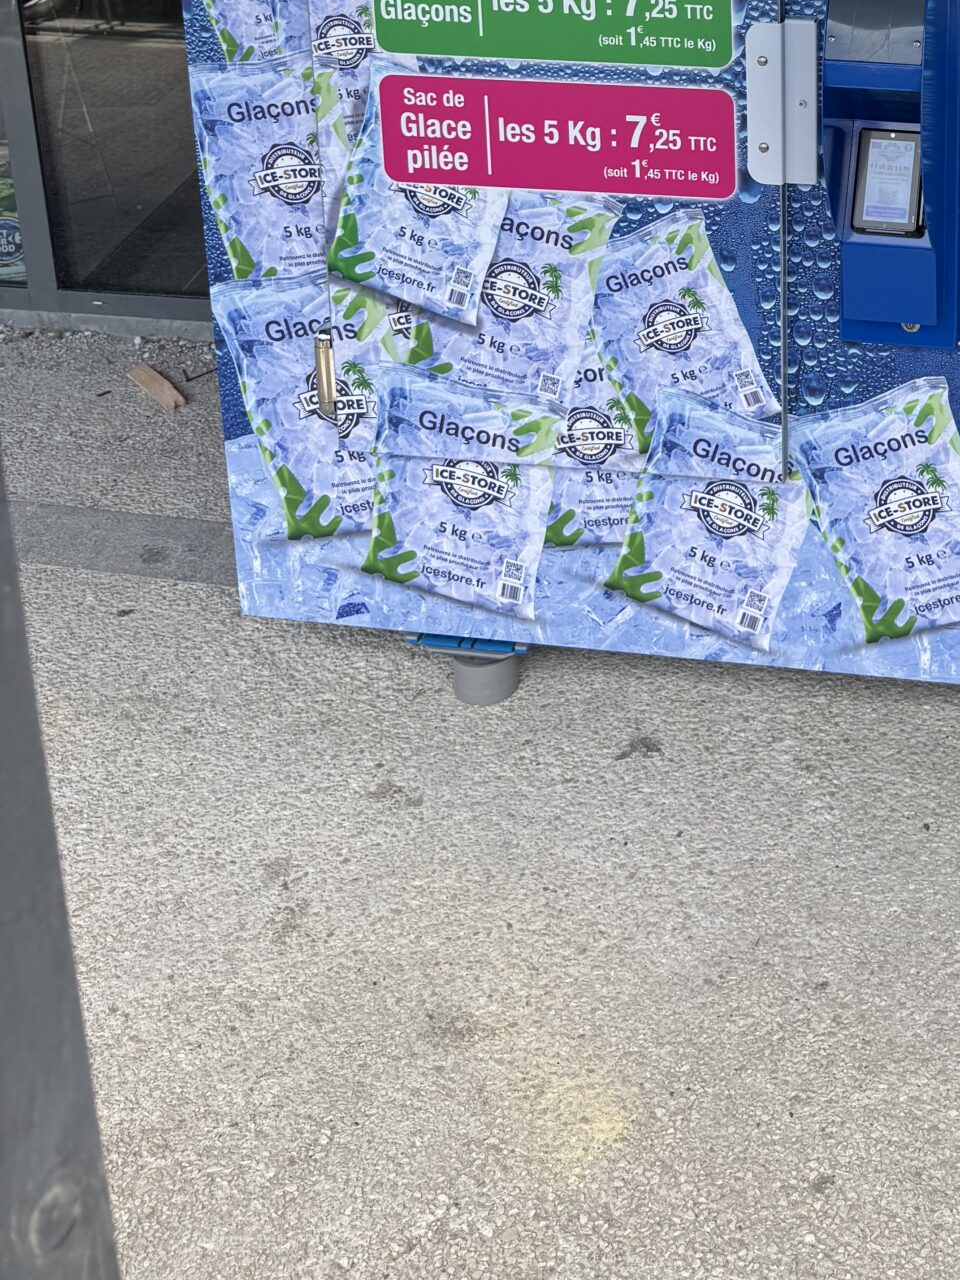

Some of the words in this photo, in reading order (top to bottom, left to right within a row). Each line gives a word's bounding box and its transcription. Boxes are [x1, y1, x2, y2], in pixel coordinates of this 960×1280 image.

[685, 4, 713, 20] TTC
[313, 38, 373, 53] ICE-STORE
[599, 34, 623, 48] (soit
[660, 37, 681, 48] TTC
[685, 38, 694, 49] le
[698, 38, 716, 52] Kg)
[403, 87, 437, 106] Sac
[443, 90, 464, 107] de
[401, 113, 471, 139] Glace
[498, 118, 535, 143] les
[544, 120, 559, 144] 5
[569, 120, 601, 151] Kg
[689, 137, 716, 152] TTC
[407, 145, 468, 173] pilée
[604, 167, 628, 180] (soit
[664, 170, 684, 181] TTC
[688, 171, 697, 181] le
[701, 171, 720, 185] Kg)
[284, 225, 292, 238] 5
[297, 224, 312, 238] kg
[398, 226, 407, 237] 5
[410, 229, 424, 246] kg
[606, 256, 688, 293] Glaçons
[643, 316, 700, 342] ICE-STORE
[477, 333, 485, 345] 5
[489, 336, 505, 353] kg
[671, 373, 679, 384] 5
[682, 370, 697, 381] kg
[419, 410, 520, 452] Glaçons
[335, 450, 344, 463] 5
[835, 429, 929, 467] Glaçons
[435, 468, 505, 496] ICE-STORE
[586, 471, 593, 483] 5
[597, 470, 613, 484] kg
[694, 494, 761, 529] ICE-STORE
[874, 495, 939, 522] ICE-STORE
[439, 522, 447, 533] 5
[452, 524, 467, 542] kg
[689, 547, 697, 558] 5
[701, 550, 717, 568] kg
[905, 556, 915, 569] 5
[917, 553, 935, 566] kg
